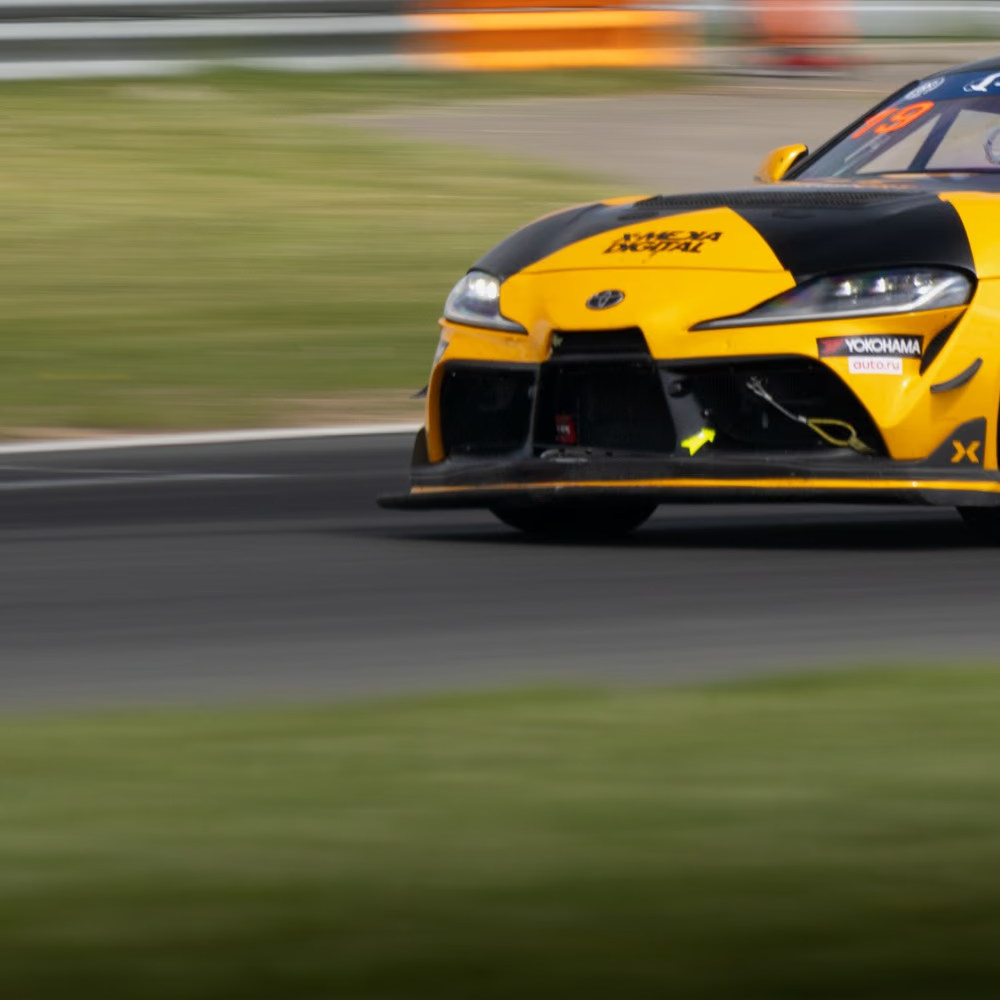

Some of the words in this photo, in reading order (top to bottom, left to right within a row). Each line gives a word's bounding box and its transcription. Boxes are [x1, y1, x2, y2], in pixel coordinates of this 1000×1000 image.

[851, 101, 936, 139] 19
[845, 337, 921, 355] YOKOHAMA
[853, 359, 900, 371] auto.ru
